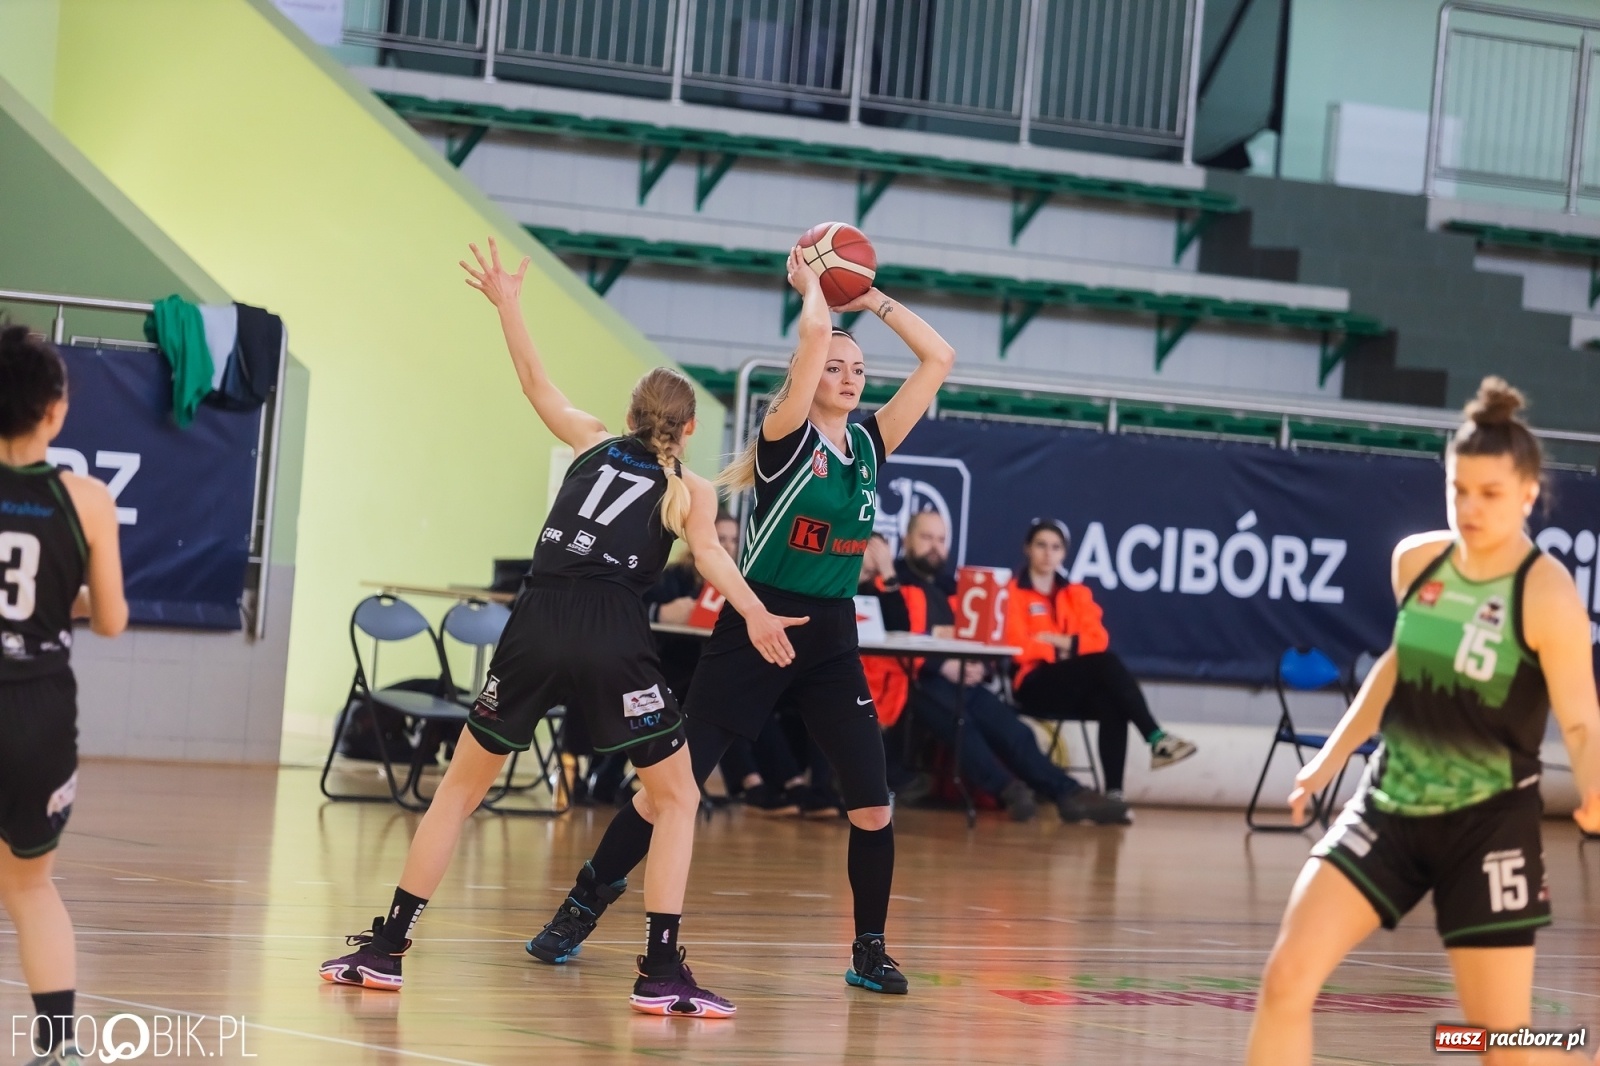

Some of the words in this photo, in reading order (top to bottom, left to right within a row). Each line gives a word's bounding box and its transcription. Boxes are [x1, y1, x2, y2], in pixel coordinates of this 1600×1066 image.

[577, 463, 656, 526] 17
[0, 531, 41, 621] 3
[1057, 509, 1347, 604] ACIBÓRZ
[1454, 623, 1503, 681] 15
[1482, 857, 1529, 913] 15
